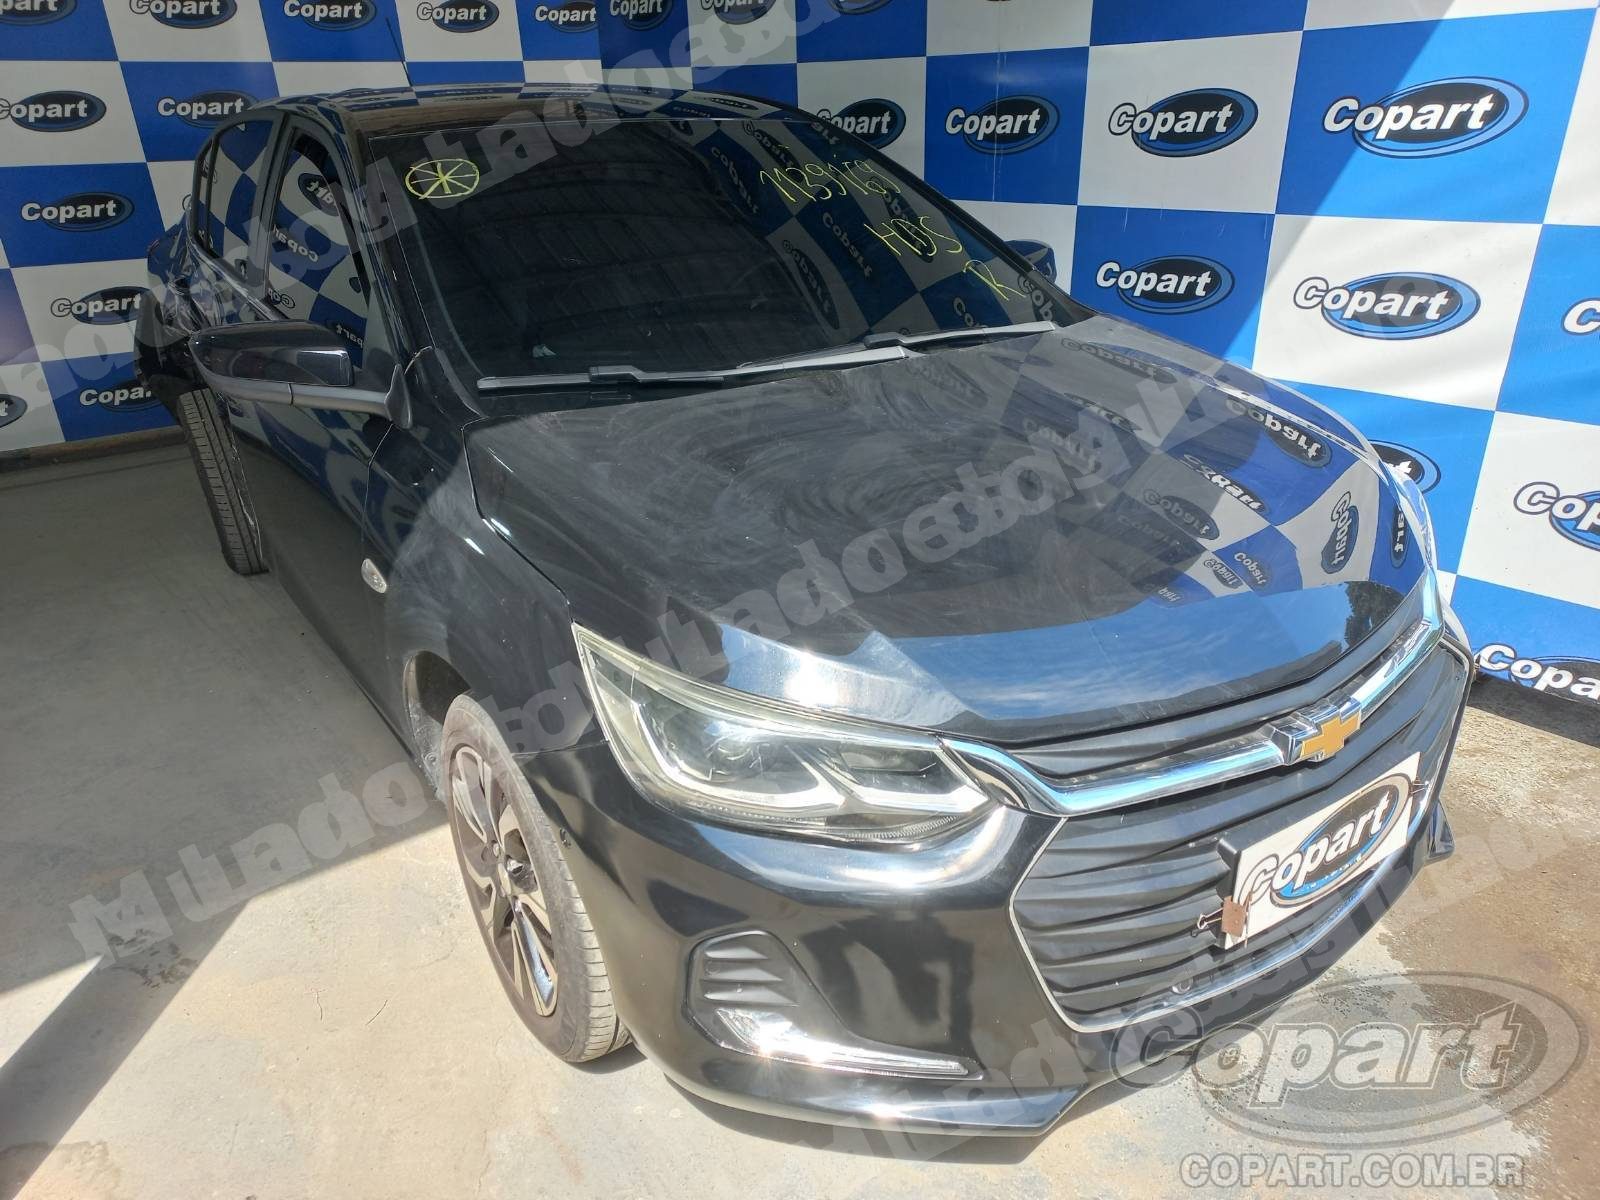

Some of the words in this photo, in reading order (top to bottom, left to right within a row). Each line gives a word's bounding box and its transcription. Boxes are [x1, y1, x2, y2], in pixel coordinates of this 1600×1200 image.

[283, 0, 363, 20] Copart
[416, 2, 488, 23] Copart
[535, 5, 597, 24] Copart
[157, 97, 245, 120] Copart
[945, 107, 1041, 140] Copart
[1108, 102, 1233, 140] Copart
[1323, 92, 1494, 141] Copart
[21, 198, 117, 226] Copart
[1095, 260, 1215, 299] Copart
[50, 290, 142, 319] Copart
[1293, 277, 1452, 323] Copart
[1238, 789, 1390, 905] Copart
